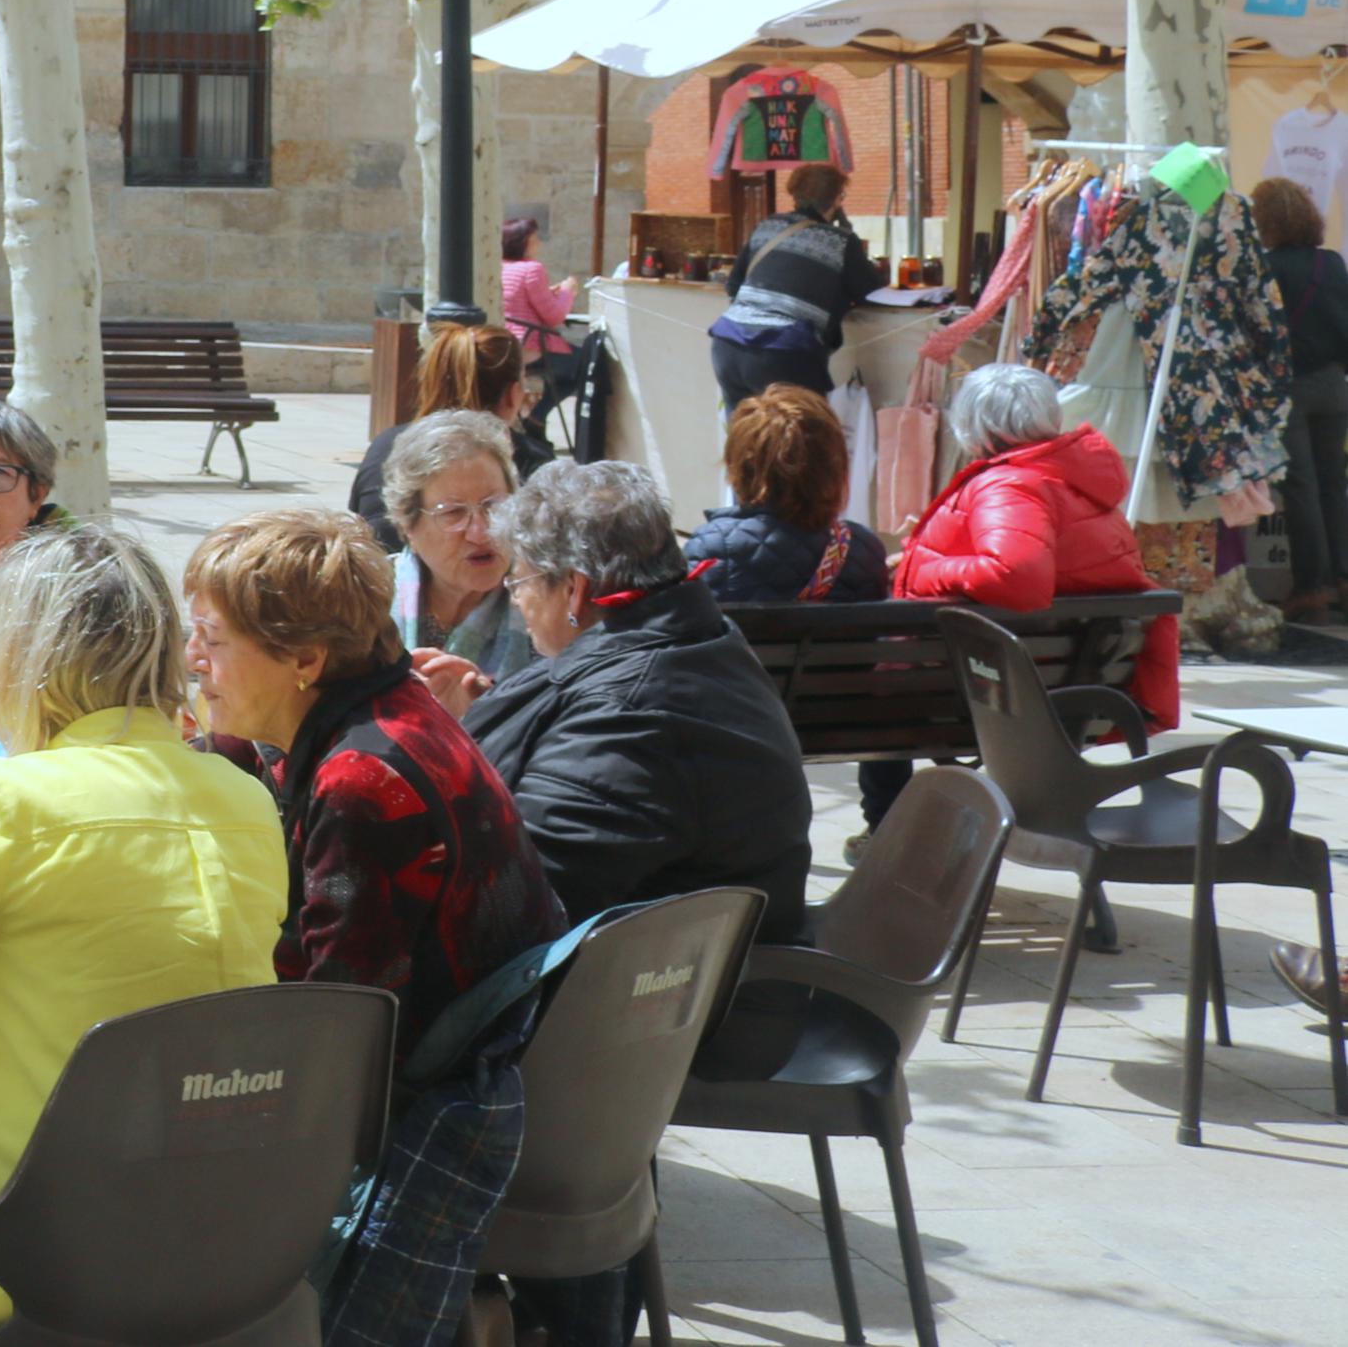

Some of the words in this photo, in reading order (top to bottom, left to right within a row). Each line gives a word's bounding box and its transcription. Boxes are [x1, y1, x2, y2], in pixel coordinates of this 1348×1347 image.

[768, 114, 797, 128] UNA
[768, 128, 797, 142] MAT
[770, 141, 797, 156] ATA
[1268, 544, 1287, 563] de
[631, 964, 694, 997] Mahou
[181, 1068, 285, 1102] Mahou
